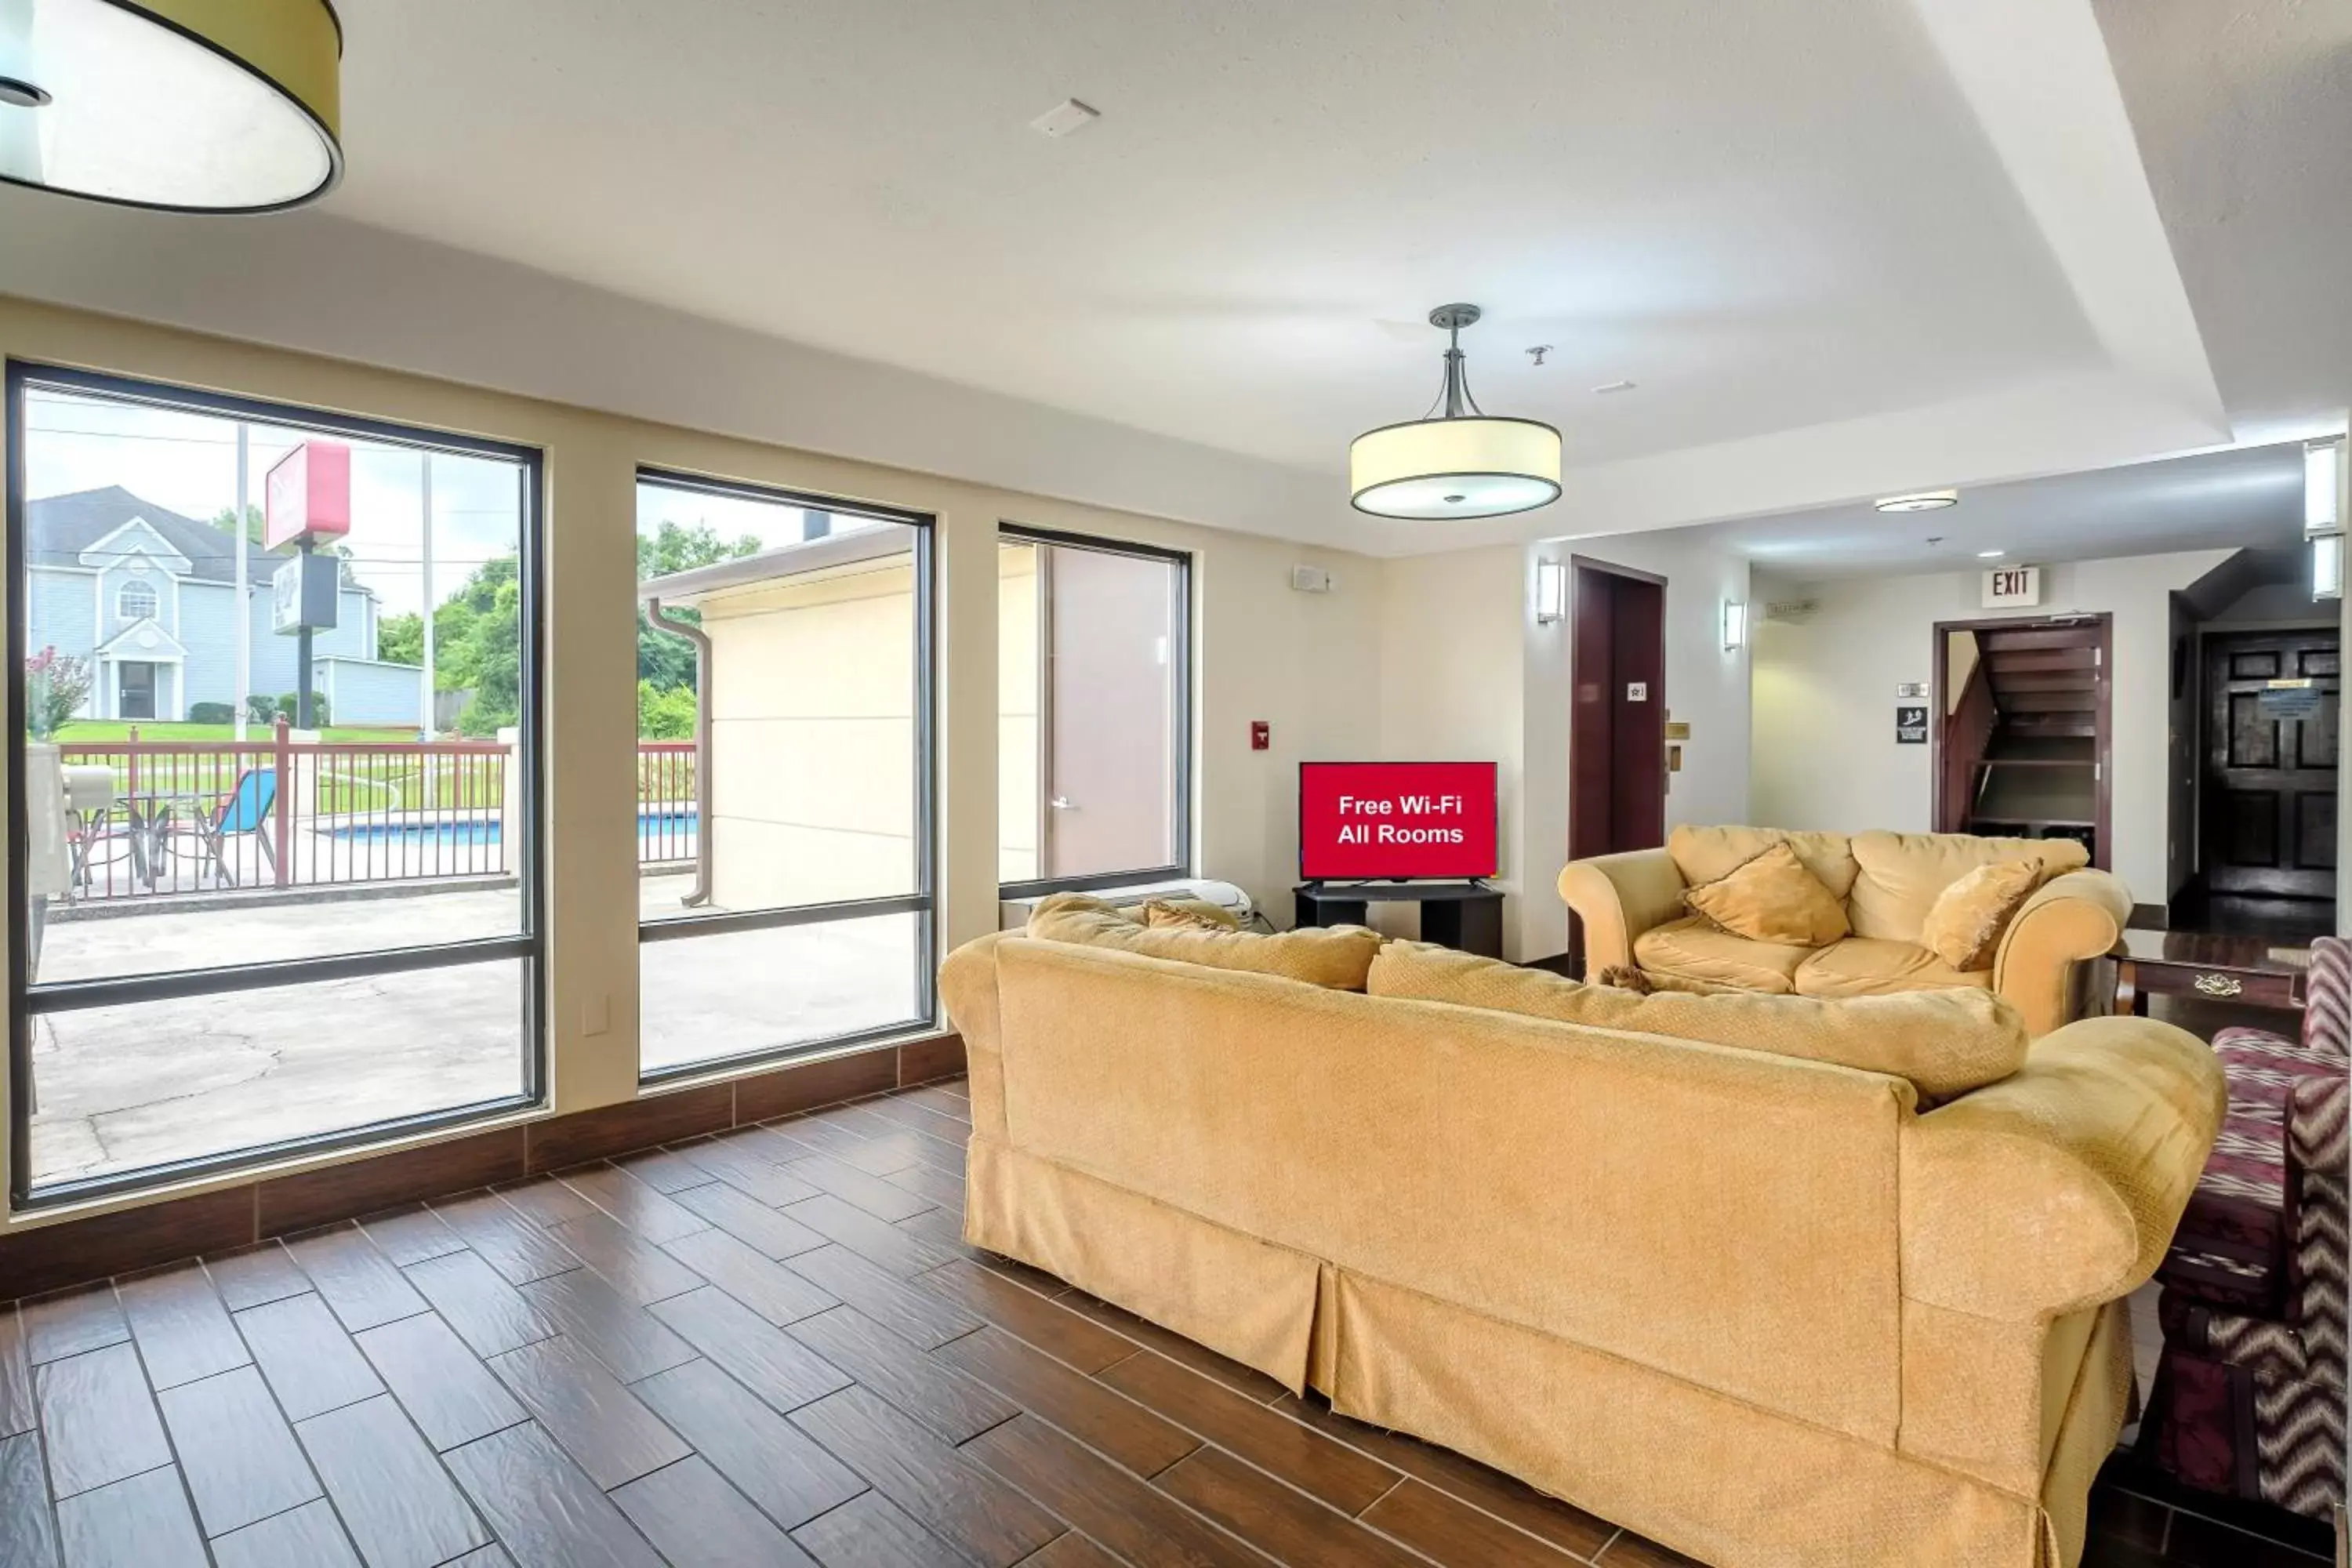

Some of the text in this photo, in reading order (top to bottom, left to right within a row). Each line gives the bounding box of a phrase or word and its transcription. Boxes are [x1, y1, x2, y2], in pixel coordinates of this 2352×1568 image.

[1993, 571, 2028, 596] EXIT
[1339, 796, 1462, 815] Free Wi-Fi
[1338, 825, 1464, 844] All Rooms
